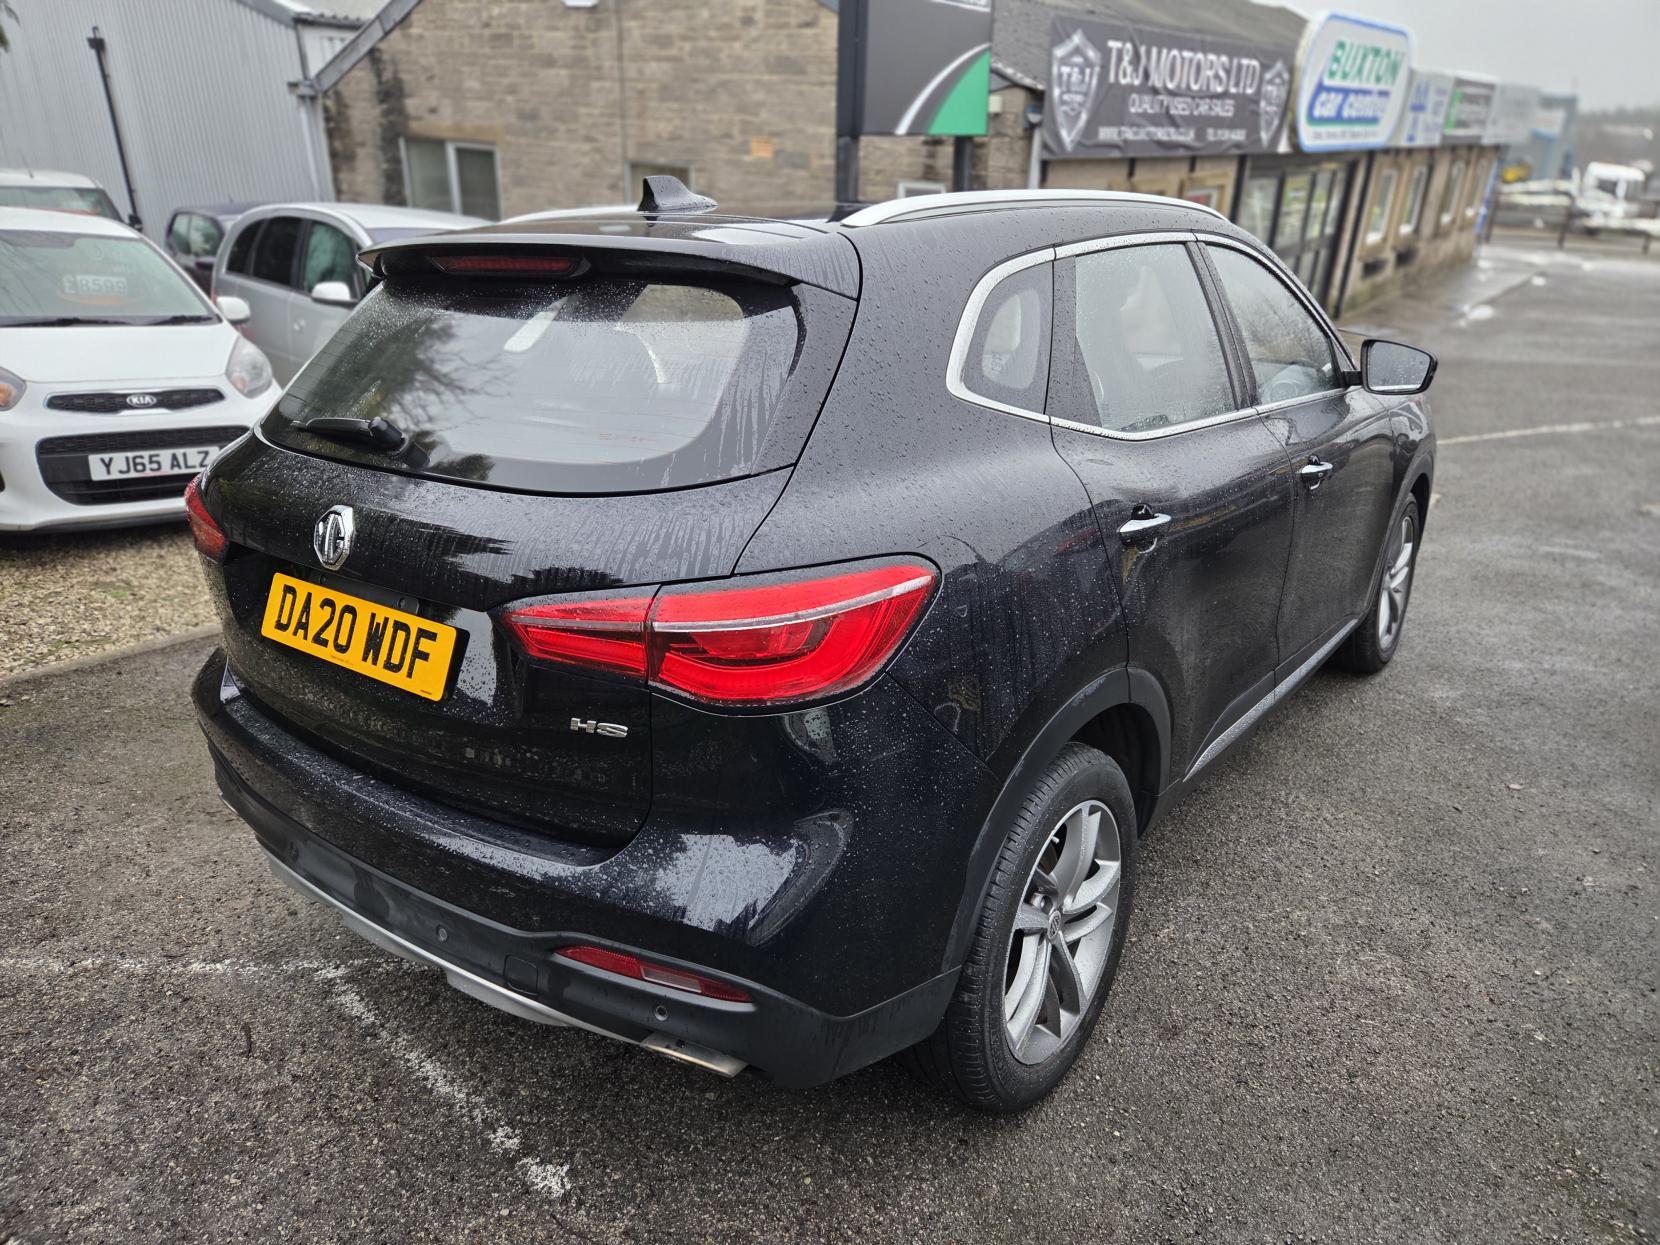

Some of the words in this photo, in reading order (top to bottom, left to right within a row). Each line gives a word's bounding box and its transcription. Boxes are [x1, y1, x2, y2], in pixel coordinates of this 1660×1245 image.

[1107, 40, 1146, 86] T&J
[1148, 46, 1230, 93] MOTORS
[1229, 57, 1260, 94] LTD
[1328, 40, 1405, 85] BUXTON
[130, 396, 153, 405] KIA
[100, 454, 162, 475] YJ65
[170, 451, 210, 470] ALZ
[275, 584, 357, 655] DA20
[361, 611, 438, 679] WDF
[570, 717, 629, 738] HS
